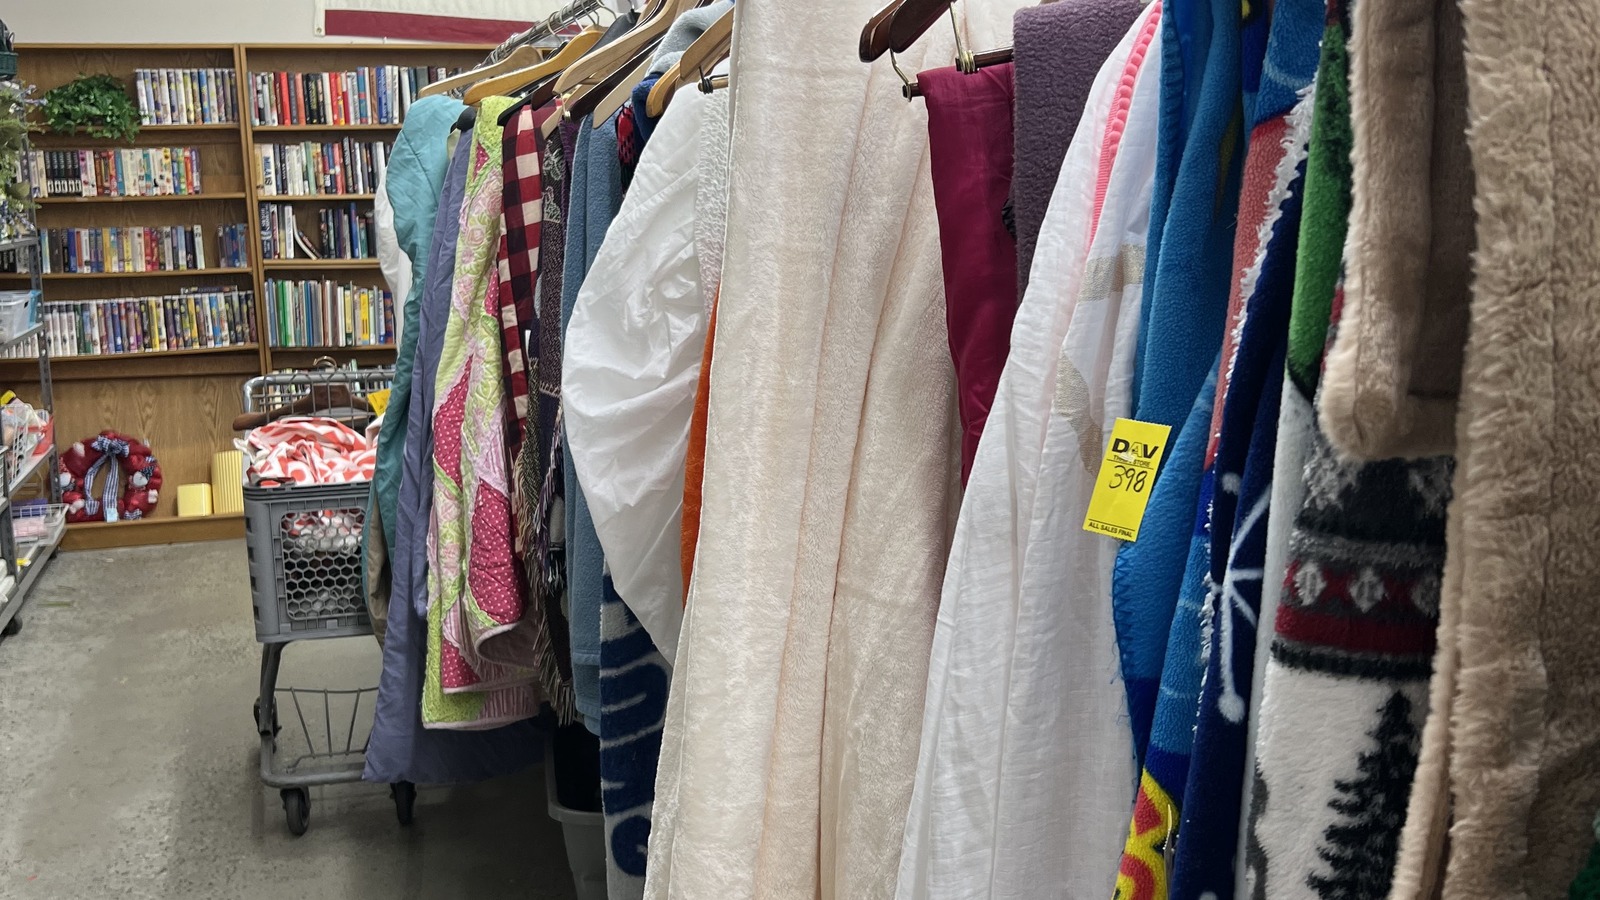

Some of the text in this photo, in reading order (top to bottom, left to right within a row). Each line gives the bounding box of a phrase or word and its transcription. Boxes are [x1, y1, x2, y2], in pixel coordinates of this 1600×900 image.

[1112, 438, 1159, 459] DAV
[1133, 459, 1151, 468] STORE
[1108, 465, 1148, 493] 398
[1088, 521, 1132, 538] ALL SALES FINAL
